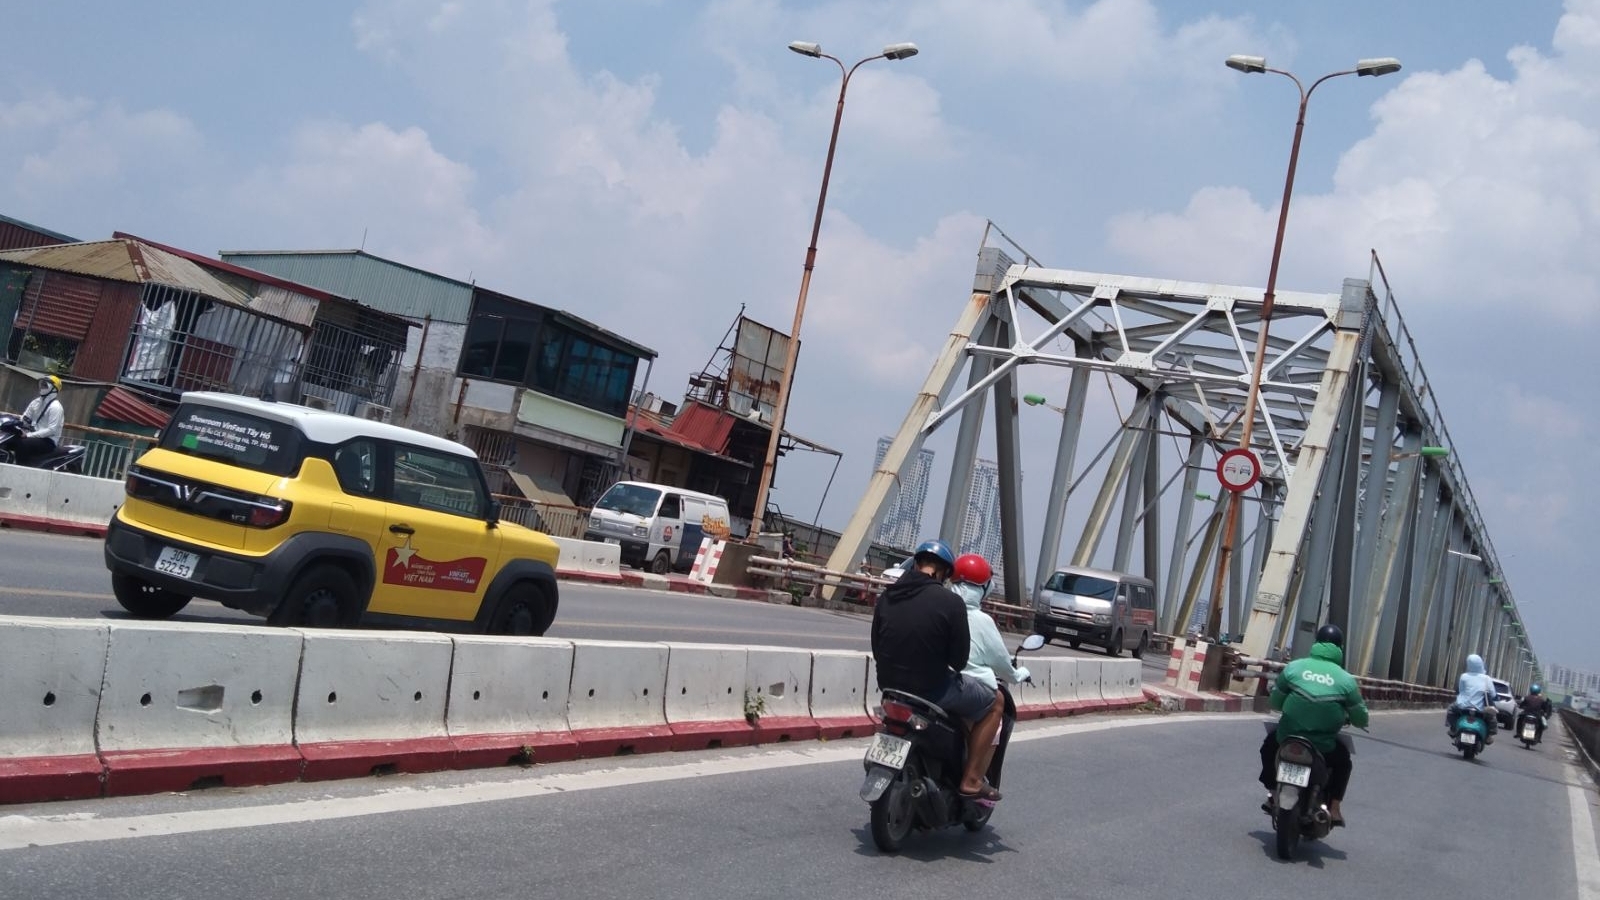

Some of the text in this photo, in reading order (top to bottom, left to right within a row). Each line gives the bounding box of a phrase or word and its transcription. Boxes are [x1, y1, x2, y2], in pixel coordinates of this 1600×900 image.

[190, 415, 221, 428] Showroom
[222, 421, 246, 434] VinFast
[247, 428, 259, 437] Tây
[170, 550, 188, 562] 30M
[158, 559, 191, 576] 522.53
[1302, 670, 1334, 686] Grab
